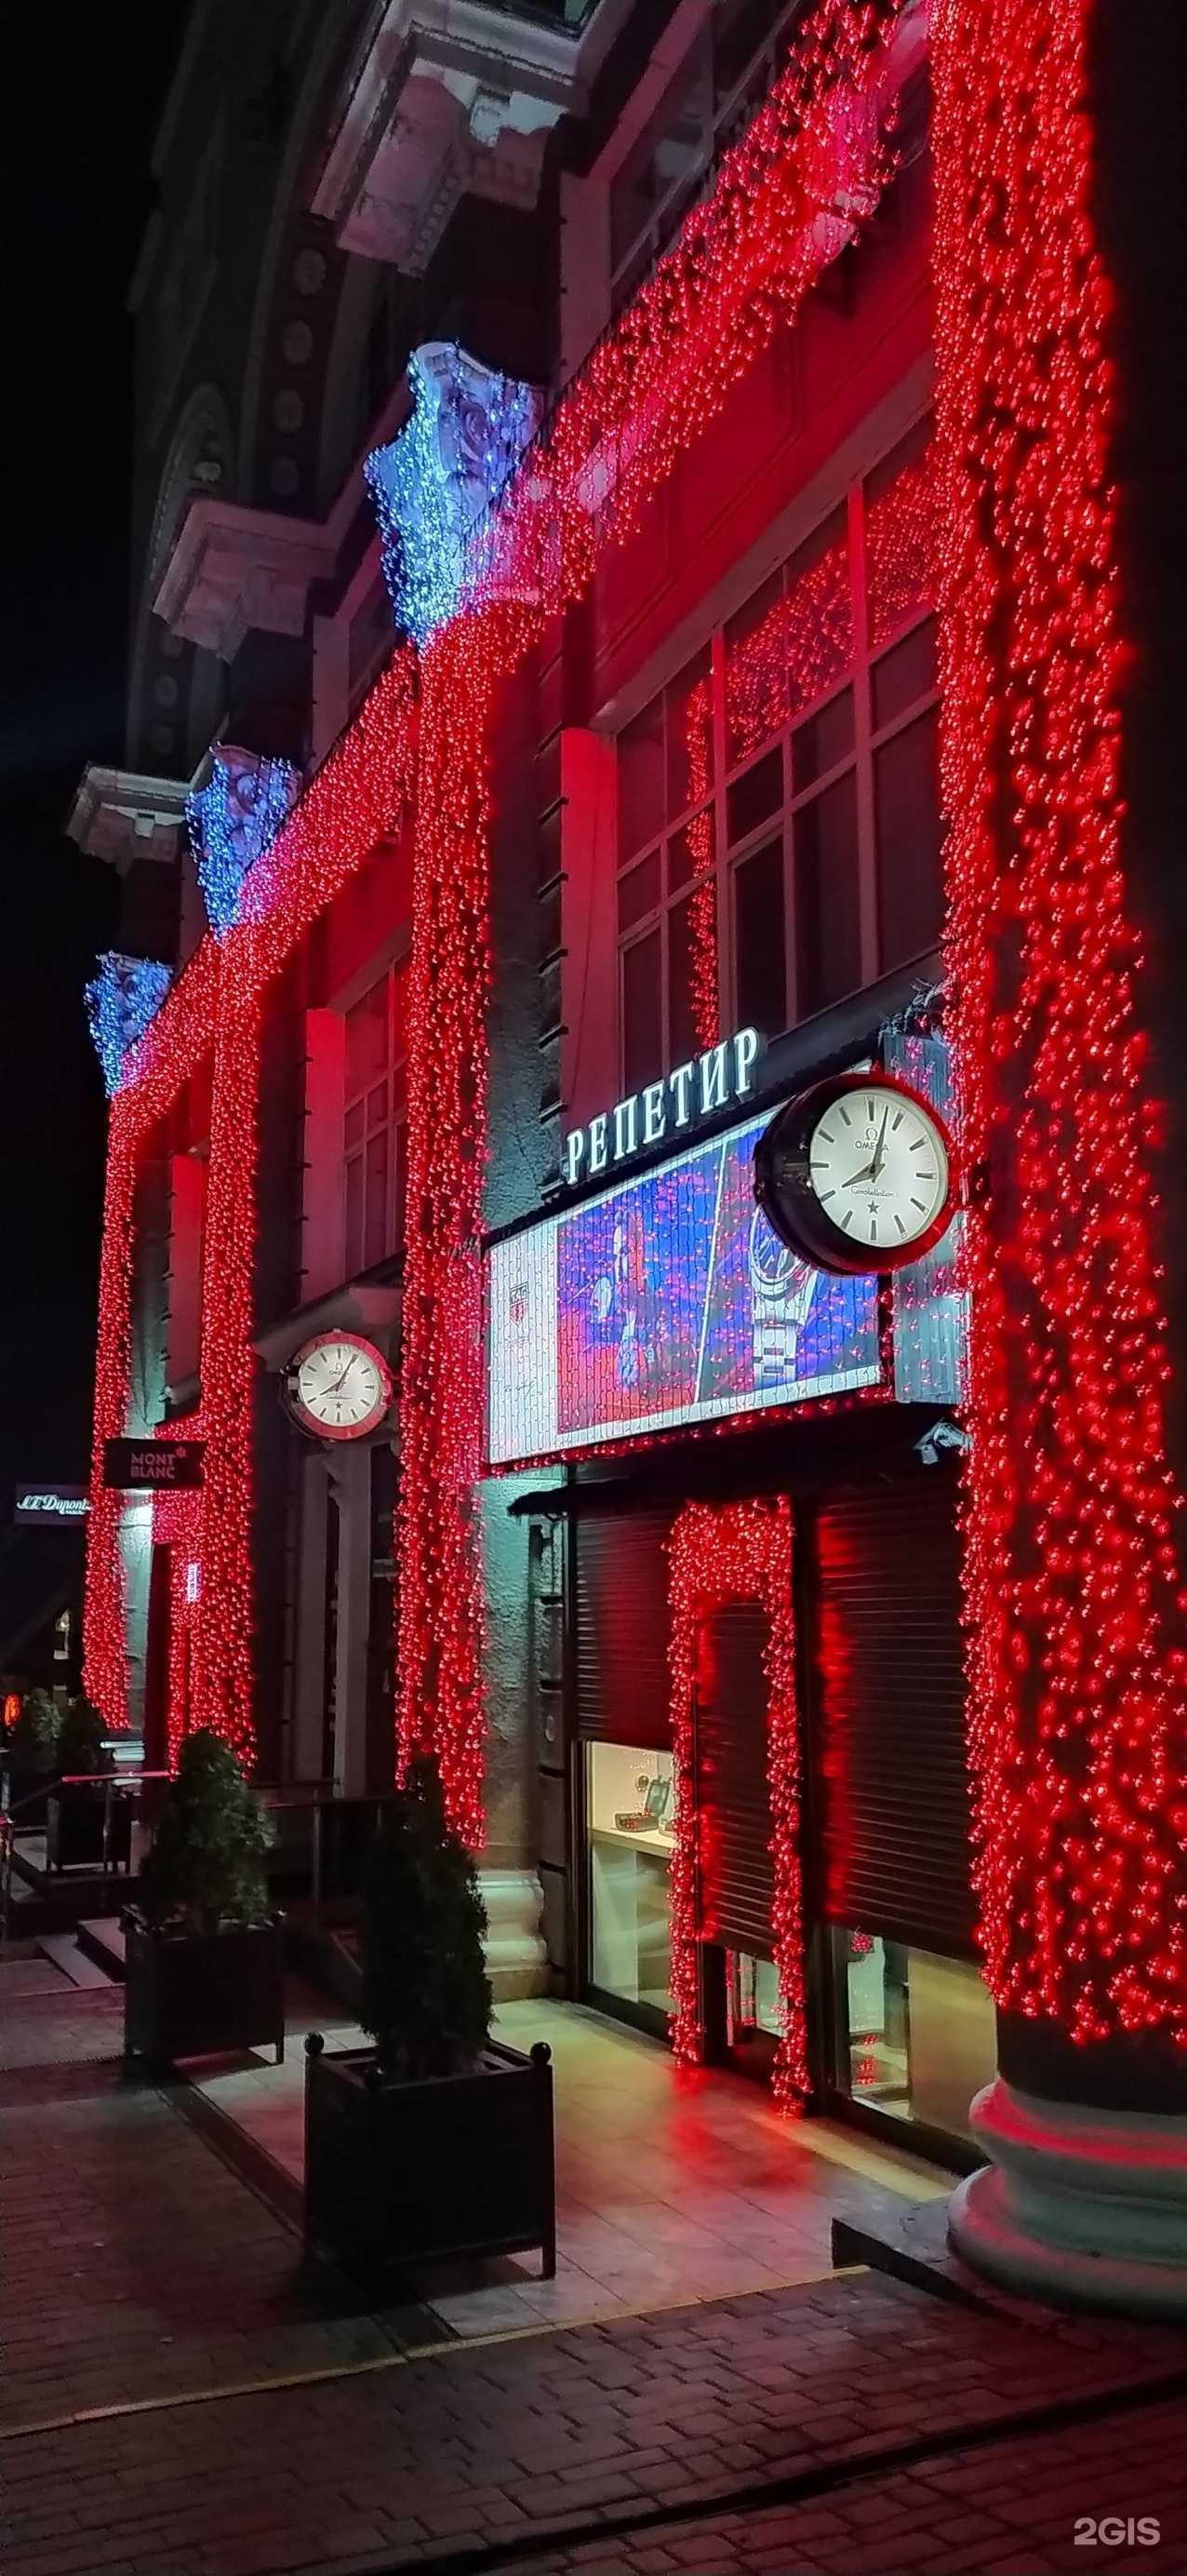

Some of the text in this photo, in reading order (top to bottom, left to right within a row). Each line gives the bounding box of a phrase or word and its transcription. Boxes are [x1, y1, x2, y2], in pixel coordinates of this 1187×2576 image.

[567, 1026, 759, 1186] РЕПЕТИР
[855, 1140, 889, 1152] OMEA
[131, 1453, 176, 1466] MONT
[130, 1466, 176, 1480] BLANC
